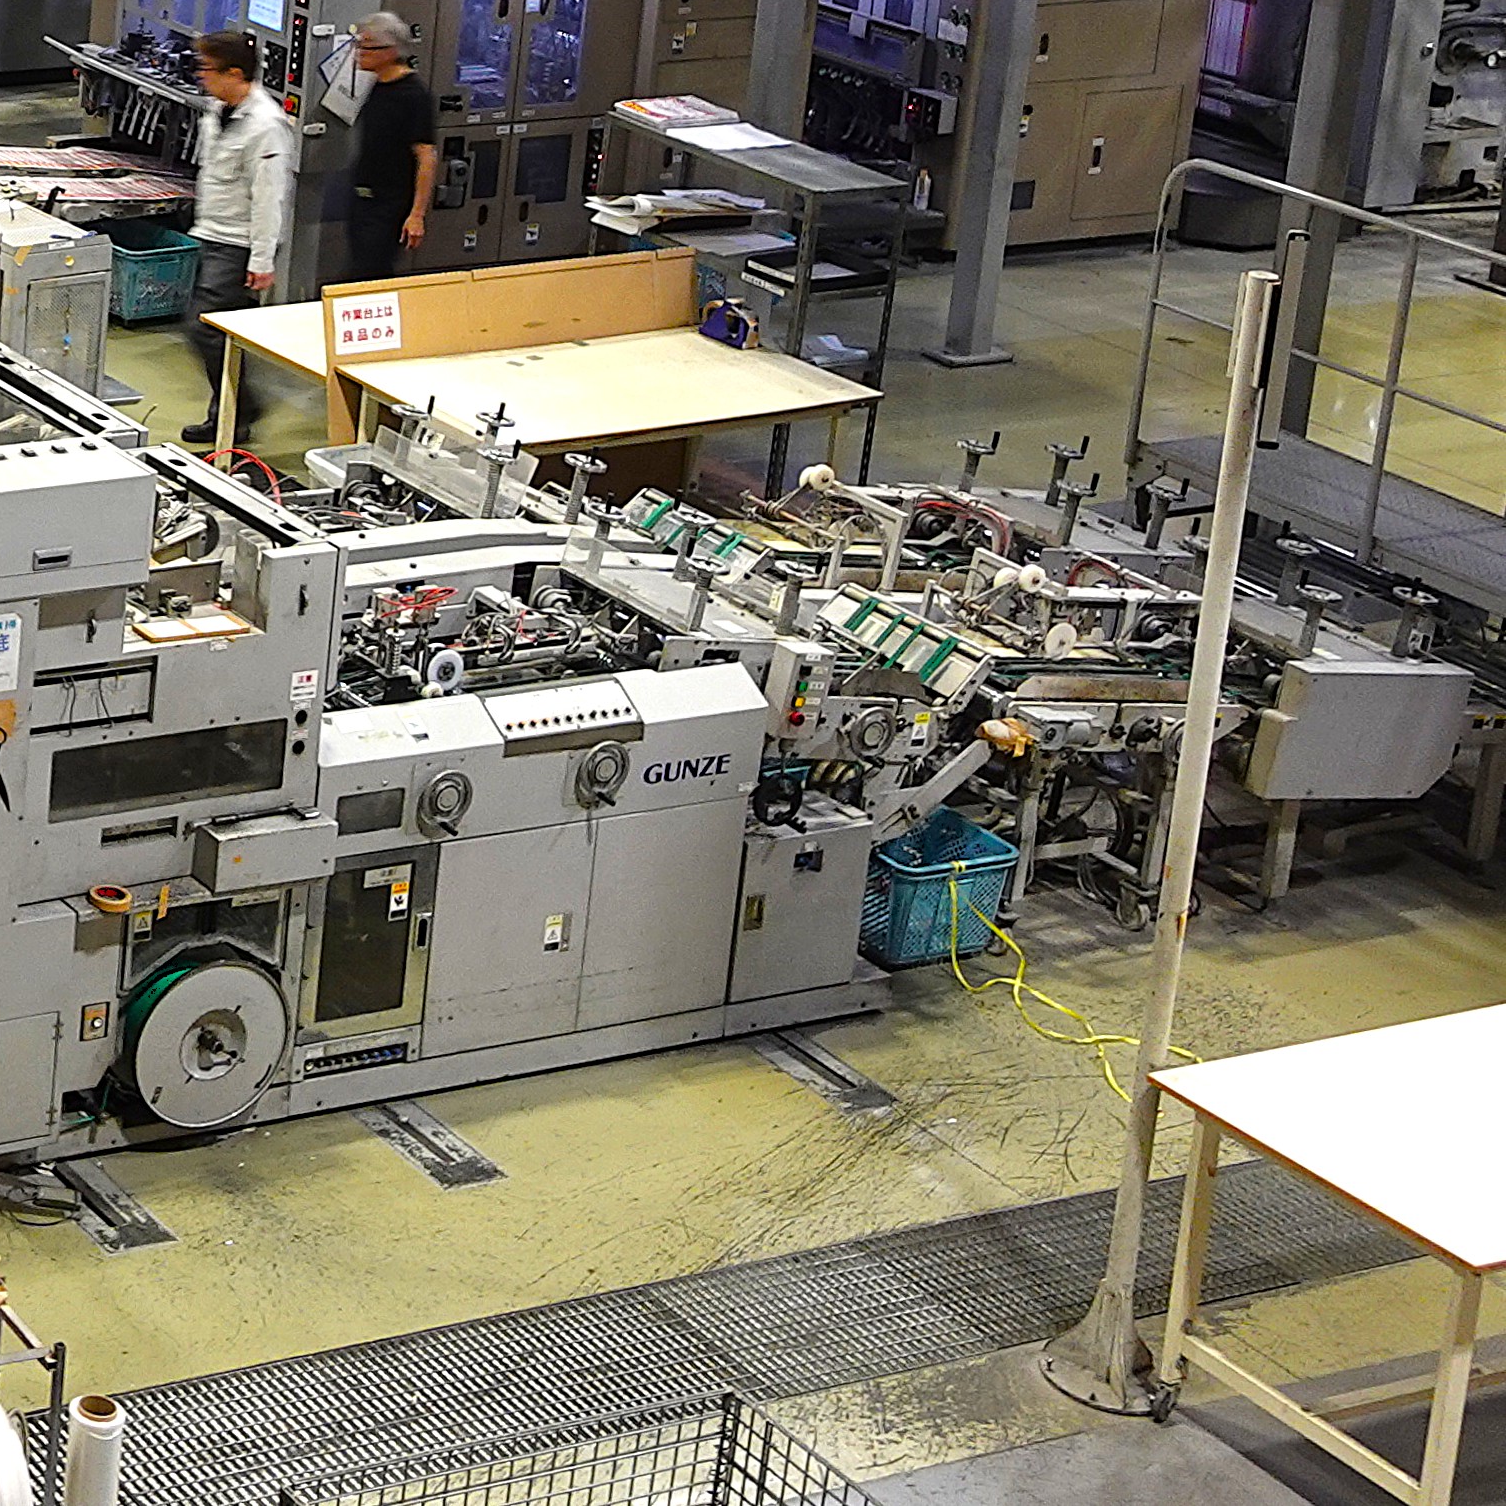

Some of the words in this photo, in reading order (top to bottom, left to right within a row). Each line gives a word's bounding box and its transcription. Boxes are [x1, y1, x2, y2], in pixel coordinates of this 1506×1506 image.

[342, 305, 394, 323] 作業台上は
[342, 325, 395, 344] 良品のみ
[643, 753, 731, 785] GUNZE
